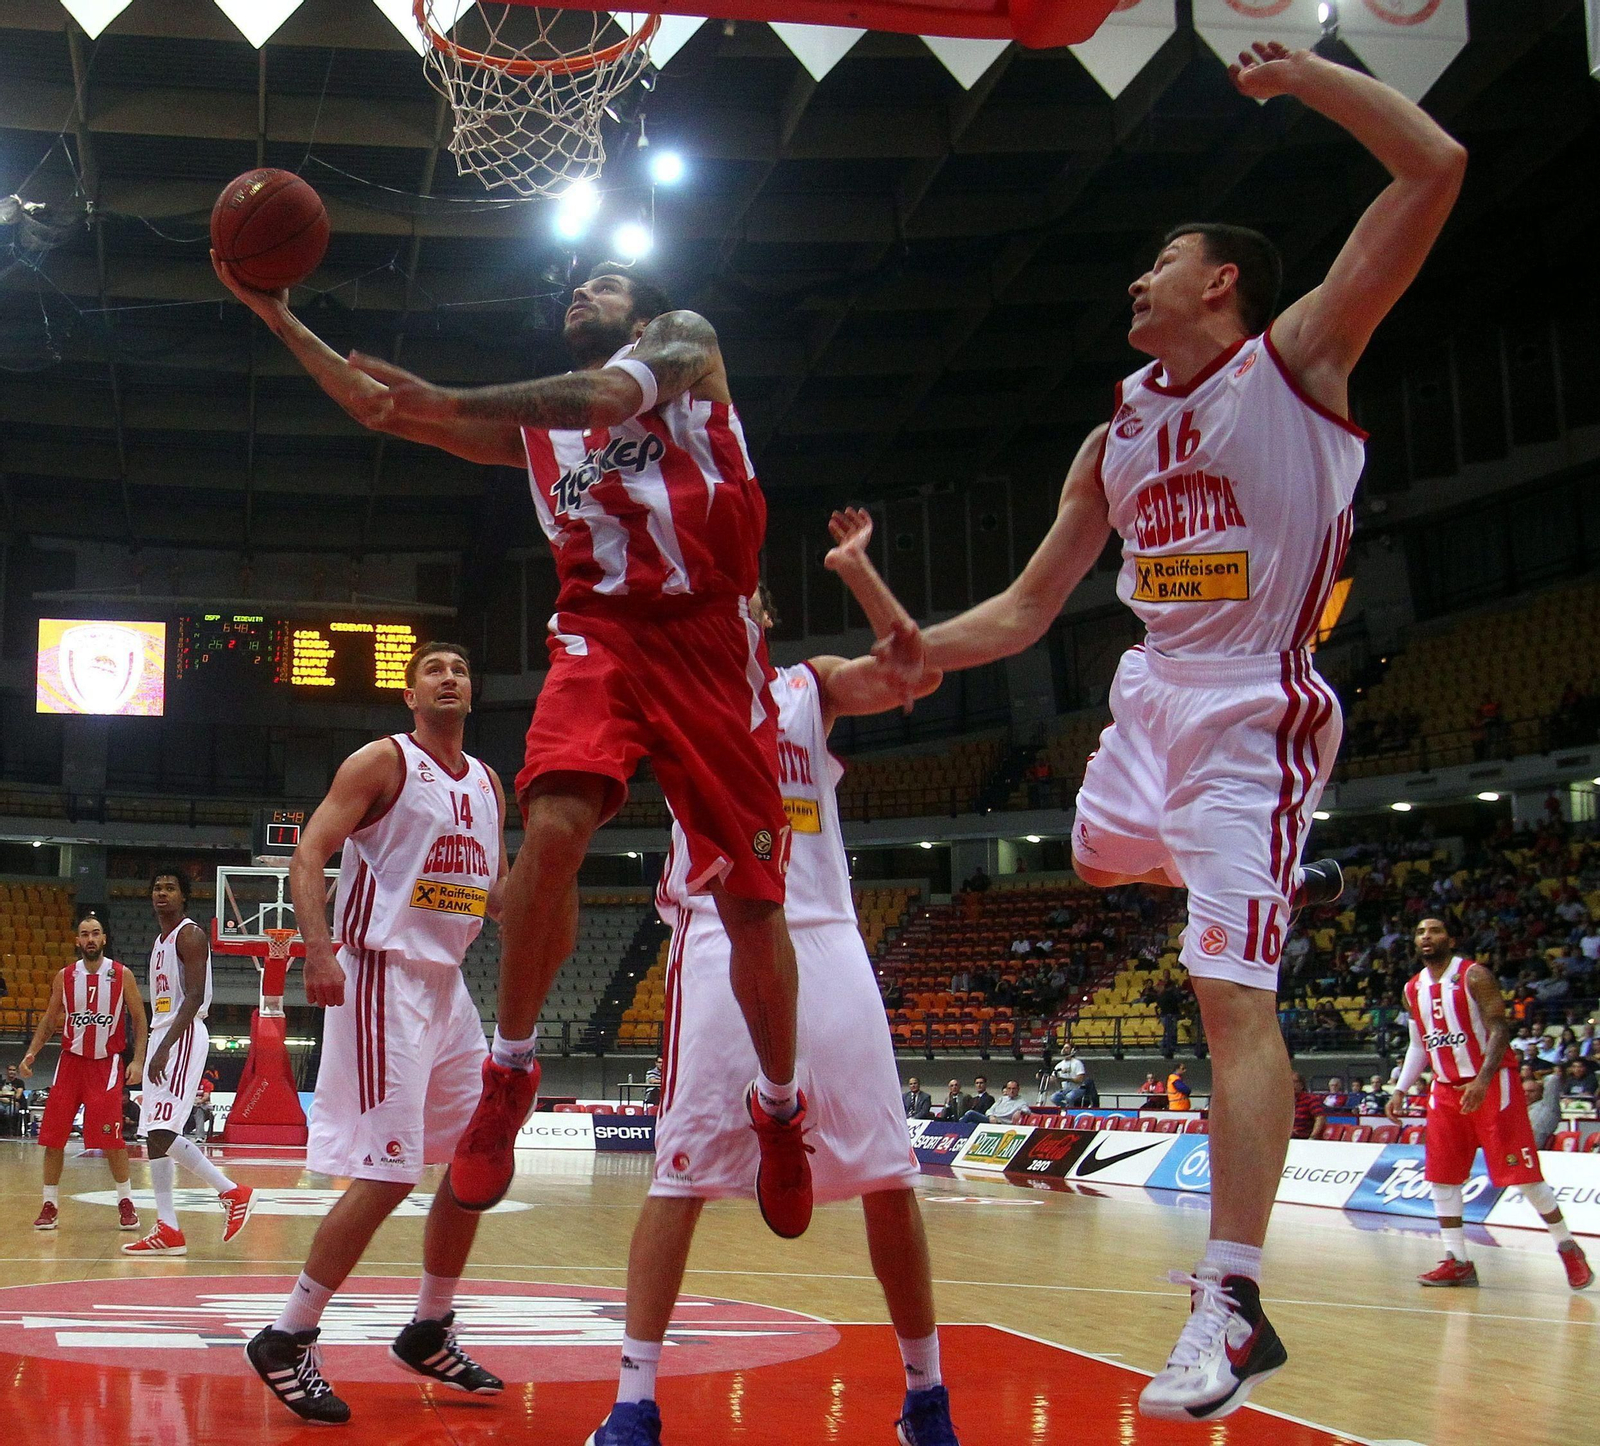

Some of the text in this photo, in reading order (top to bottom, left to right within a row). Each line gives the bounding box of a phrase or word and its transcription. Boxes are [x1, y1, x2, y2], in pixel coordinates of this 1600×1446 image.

[1157, 409, 1201, 473] 16
[1153, 560, 1240, 578] Raiffeisen
[1158, 581, 1203, 599] BANK
[330, 622, 374, 632] CEDEVITA
[449, 790, 473, 830] 14
[423, 834, 490, 877] CEDEVITA
[437, 899, 473, 913] BANK
[1243, 898, 1281, 966] 16
[88, 986, 97, 1004] 7
[1431, 997, 1444, 1020] 5
[153, 1101, 174, 1122] 20
[114, 1121, 121, 1139] 7
[521, 1127, 591, 1137] UGEOT
[595, 1126, 652, 1140] SPORT
[1026, 1159, 1052, 1172] zero
[1520, 1146, 1534, 1169] 5
[1281, 1165, 1364, 1185] EUGEOT
